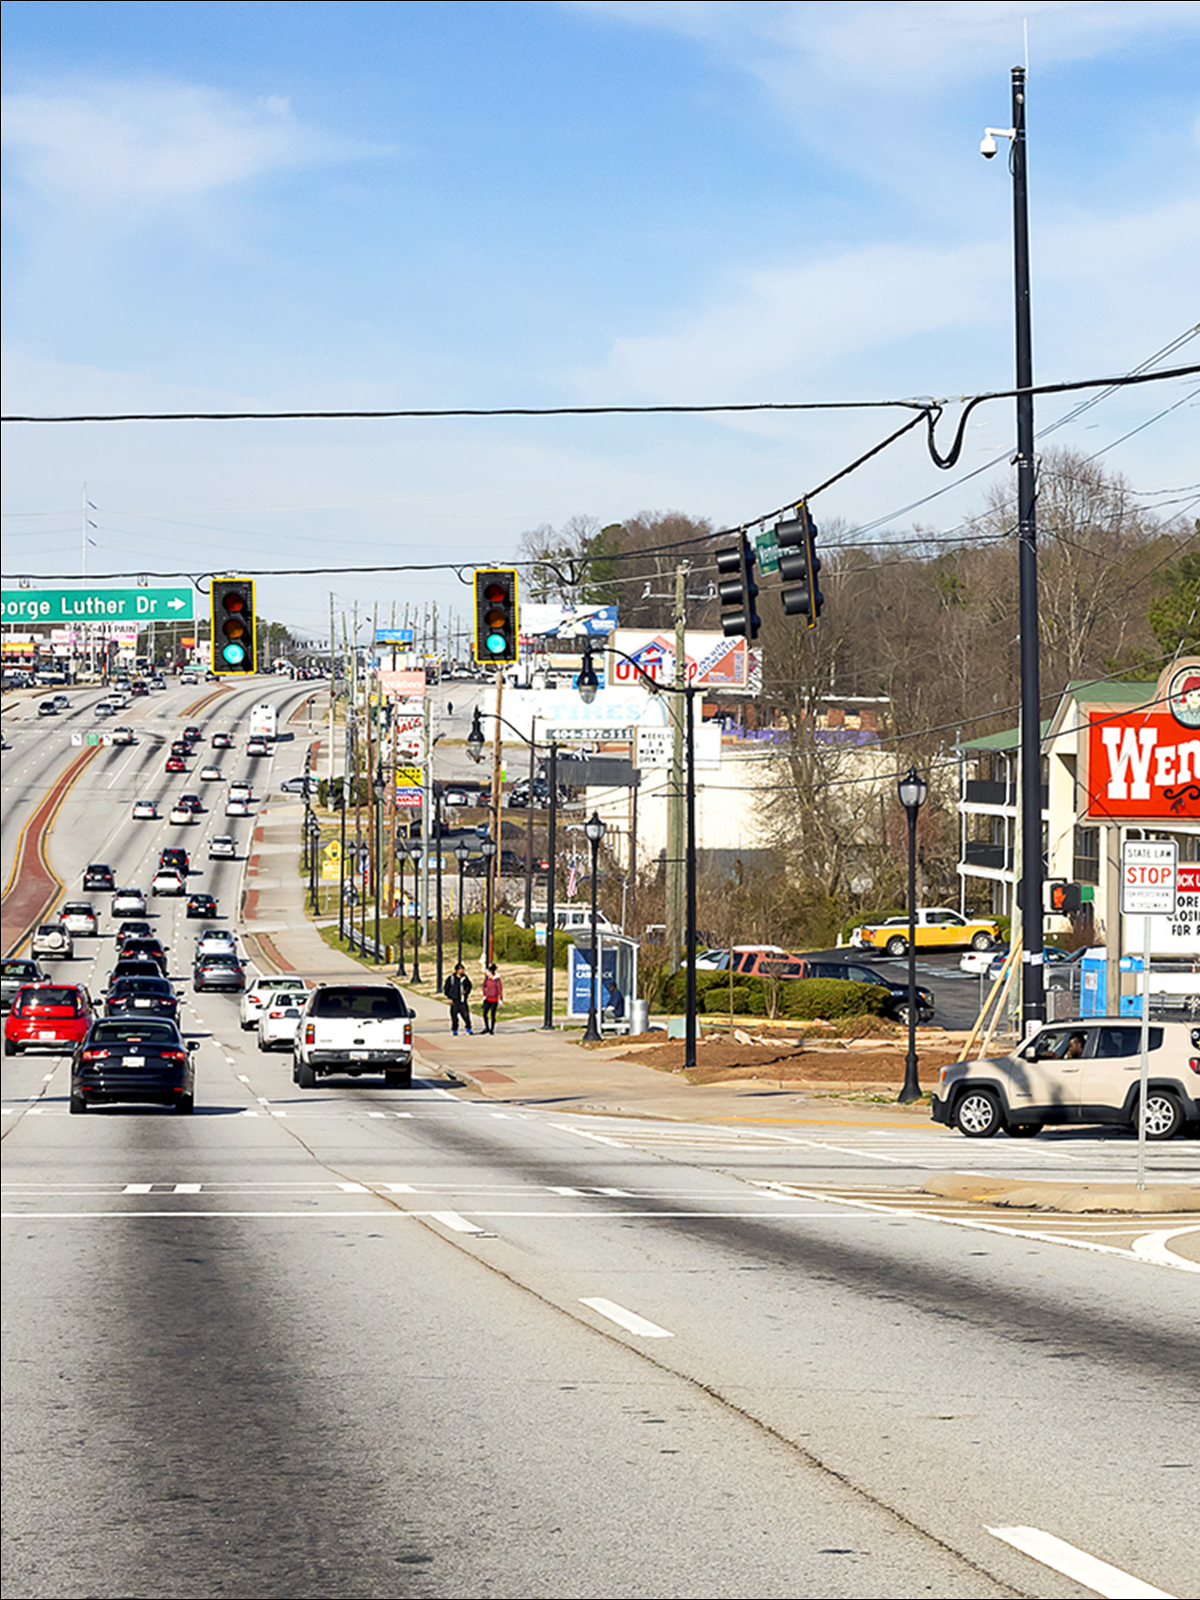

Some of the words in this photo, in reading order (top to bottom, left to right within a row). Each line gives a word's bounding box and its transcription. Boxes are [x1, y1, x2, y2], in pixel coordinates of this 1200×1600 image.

[1, 600, 51, 620] eorge
[61, 596, 126, 614] Luther
[136, 596, 158, 613] Dr
[616, 661, 698, 681] UNID
[548, 704, 642, 721] TIRES
[1127, 848, 1151, 859] STATE
[1154, 849, 1172, 859] LAW
[1126, 866, 1172, 885] STOP
[1176, 874, 1195, 887] ICK
[1177, 895, 1199, 908] ORE
[1172, 924, 1191, 936] FOR
